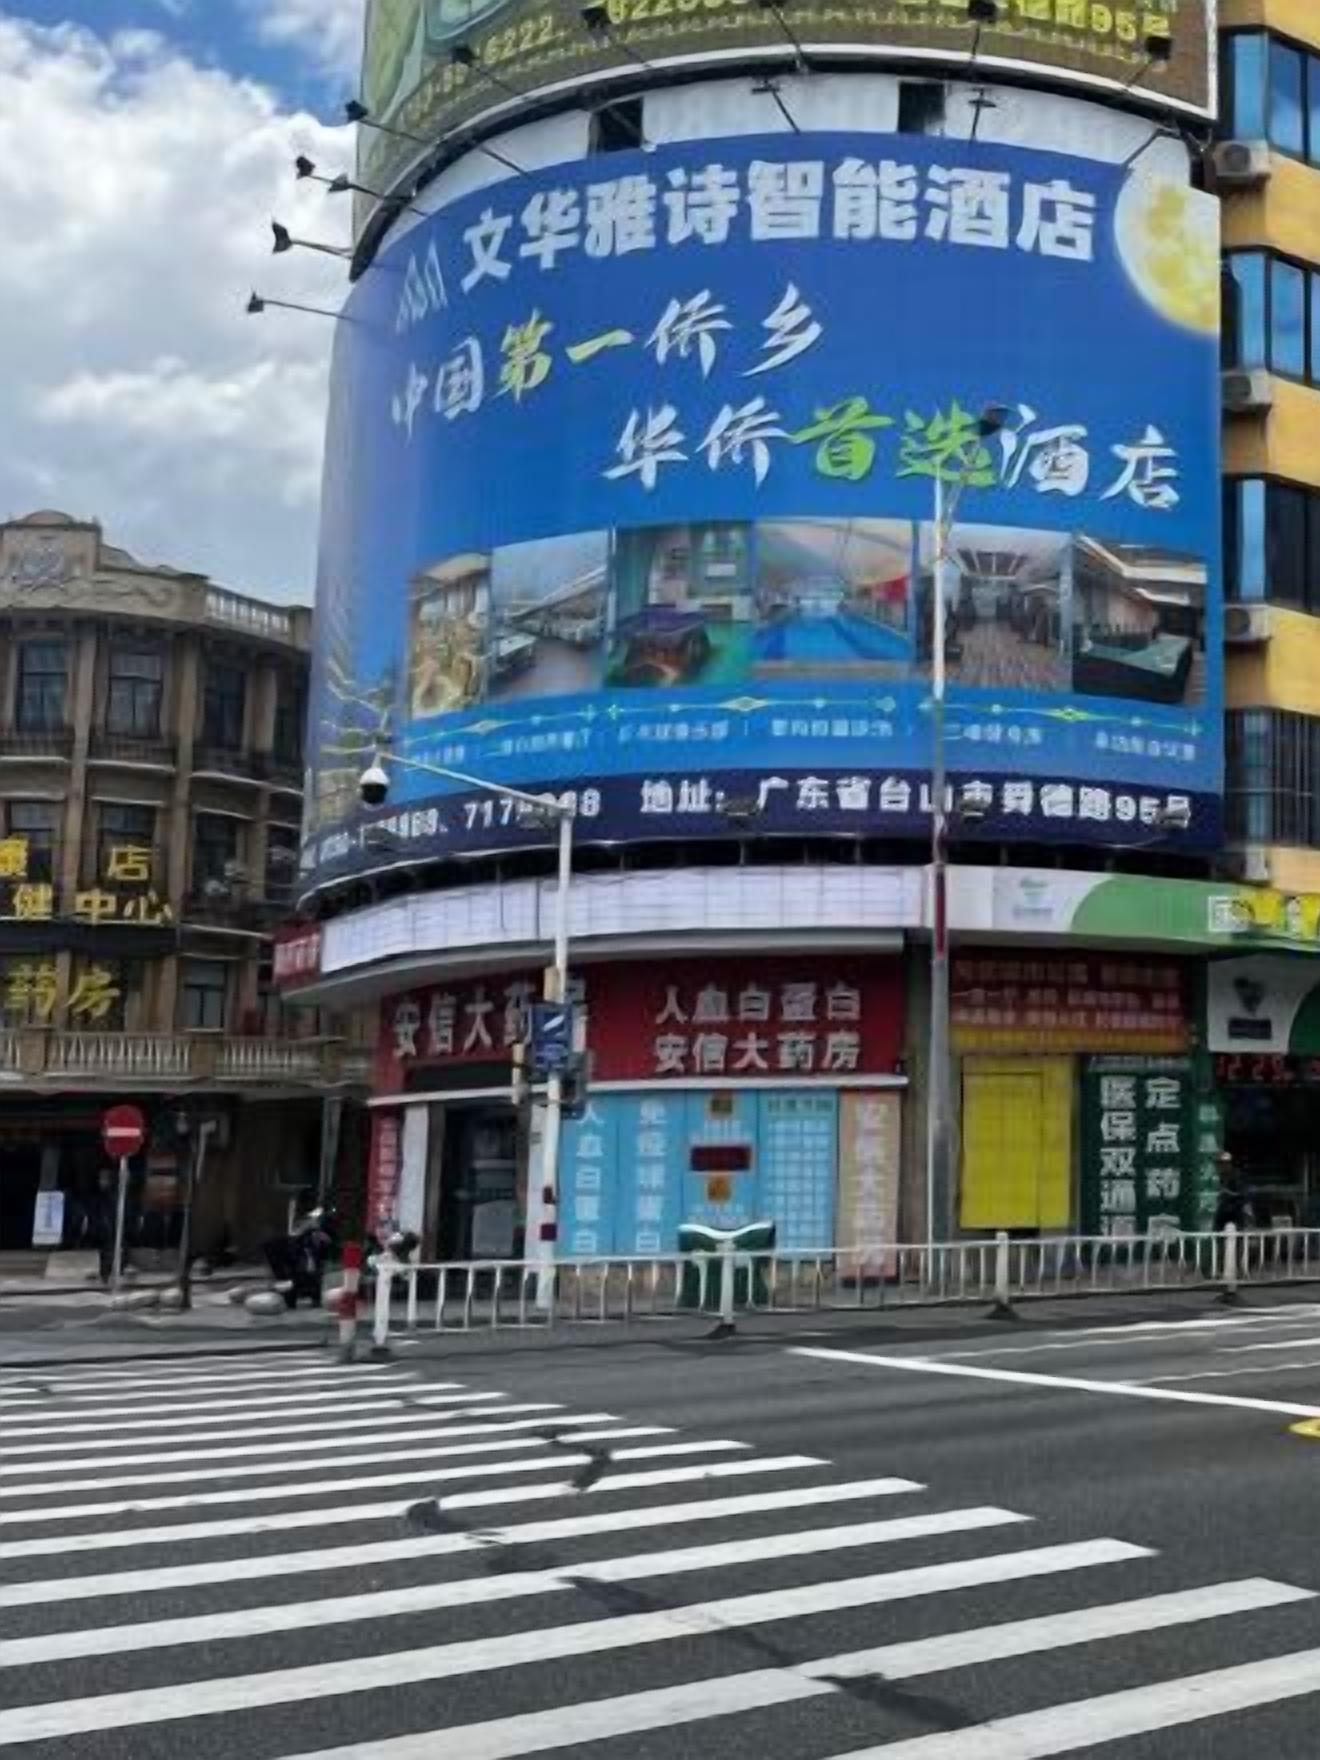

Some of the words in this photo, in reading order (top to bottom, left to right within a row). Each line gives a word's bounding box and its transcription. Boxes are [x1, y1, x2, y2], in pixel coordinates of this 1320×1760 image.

[461, 157, 1096, 294] 文华雅诗智能酒店
[390, 281, 824, 441] 中国第一侨乡
[602, 397, 1181, 513] 华侨首选酒店
[653, 1030, 862, 1075] 安信大药房
[654, 981, 862, 1024] 人血白蛋白
